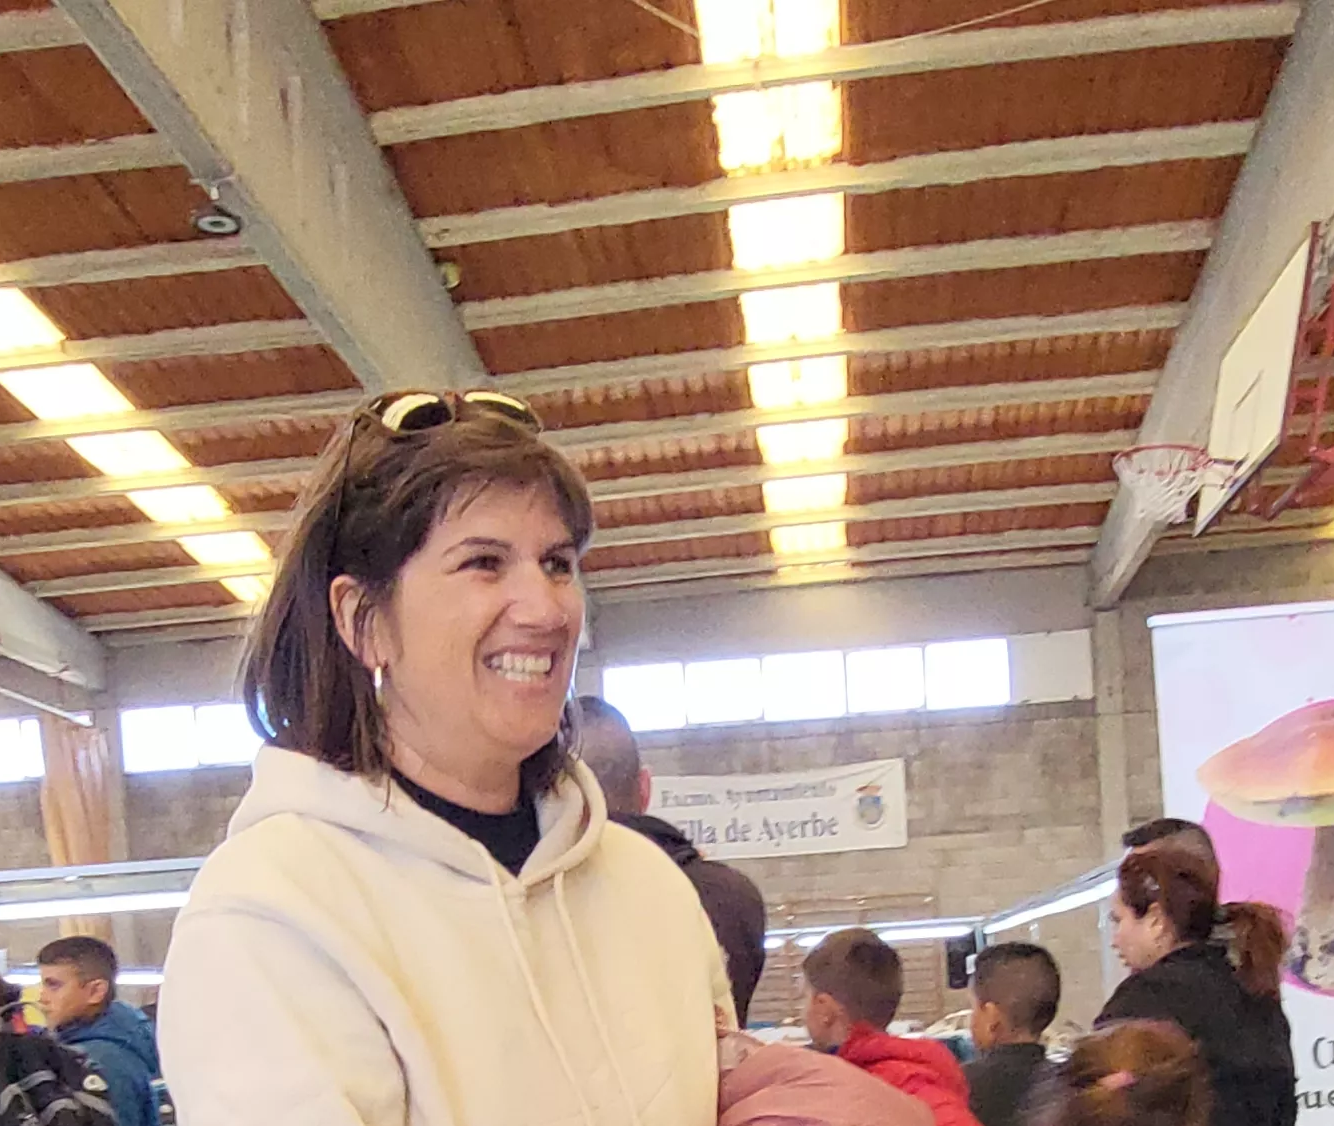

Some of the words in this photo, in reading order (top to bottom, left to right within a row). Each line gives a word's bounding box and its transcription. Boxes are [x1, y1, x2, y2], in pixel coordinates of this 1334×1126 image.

[674, 818, 718, 845] illa
[725, 816, 752, 843] de
[757, 810, 840, 847] Ayerbe
